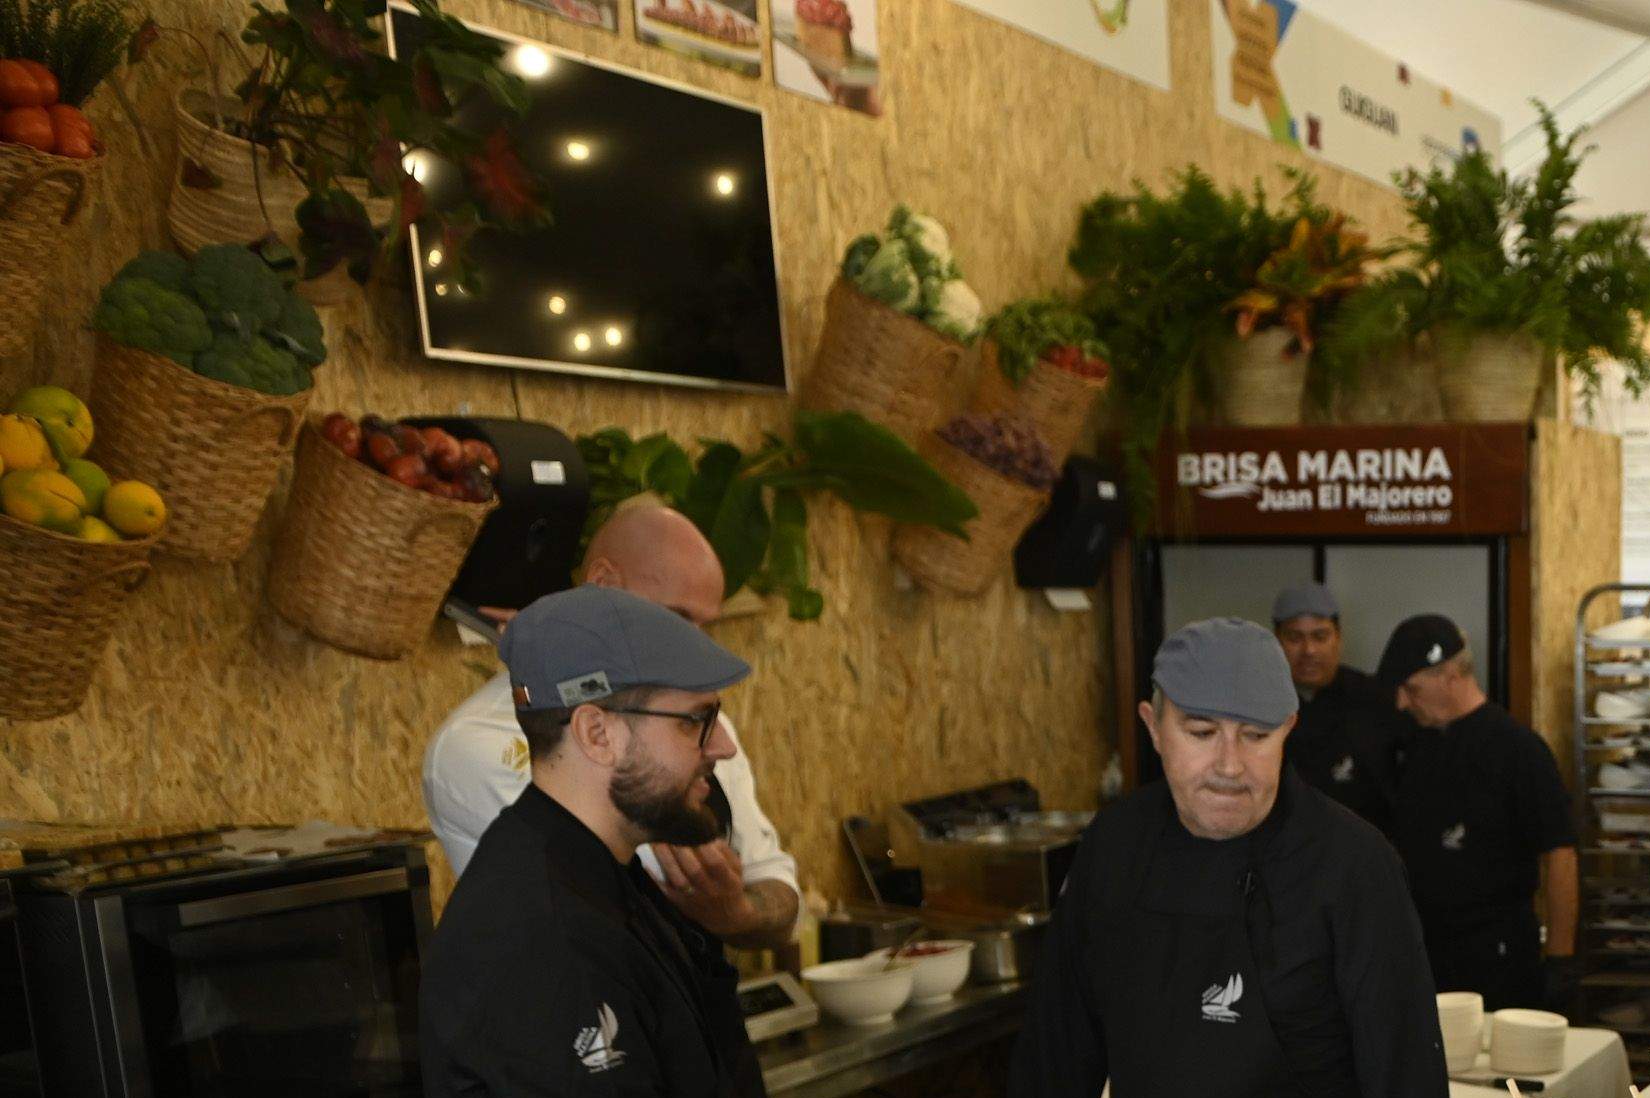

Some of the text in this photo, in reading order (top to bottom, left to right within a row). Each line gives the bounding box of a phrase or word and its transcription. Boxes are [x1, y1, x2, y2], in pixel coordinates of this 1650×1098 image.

[1177, 447, 1452, 485] BRISA MARINA
[1257, 483, 1452, 511] Juan El Majorero
